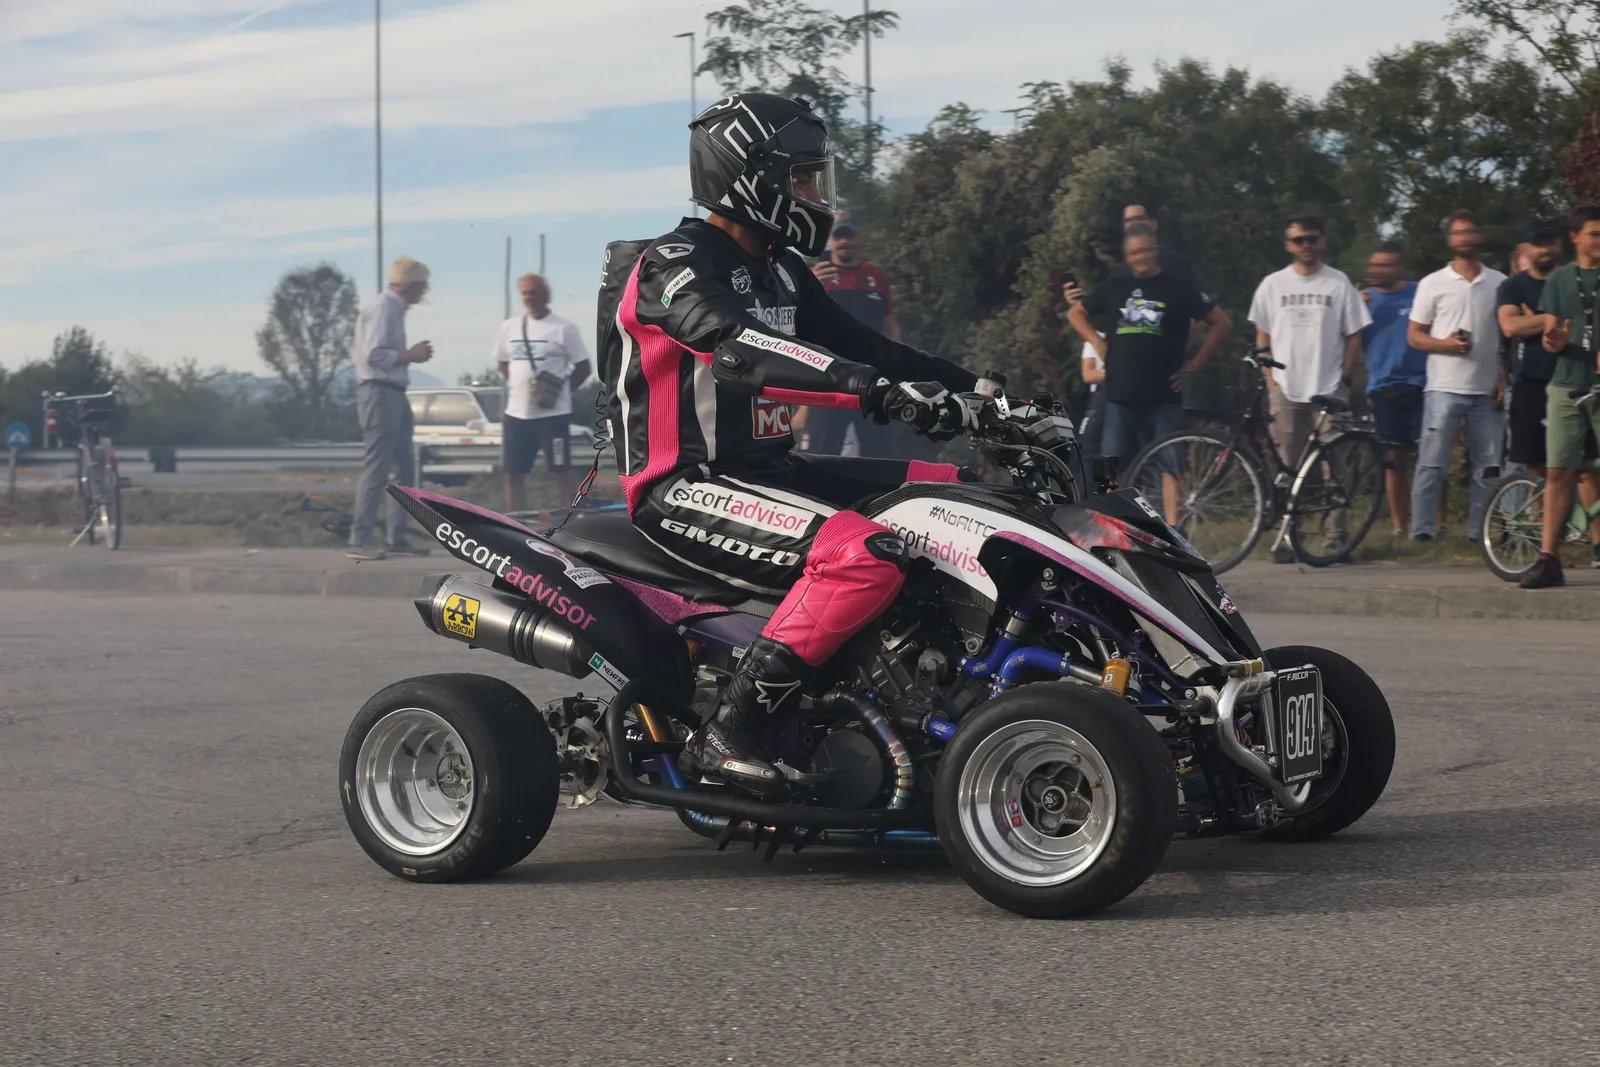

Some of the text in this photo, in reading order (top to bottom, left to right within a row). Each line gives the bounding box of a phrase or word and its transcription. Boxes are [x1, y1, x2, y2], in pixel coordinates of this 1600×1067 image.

[741, 331, 829, 367] escortadvisor
[672, 486, 808, 531] escortadvisor
[659, 517, 801, 567] GIMOTO
[435, 522, 596, 631] escortadvisor
[446, 621, 474, 637] ARROW
[603, 664, 626, 687] NEWFRE
